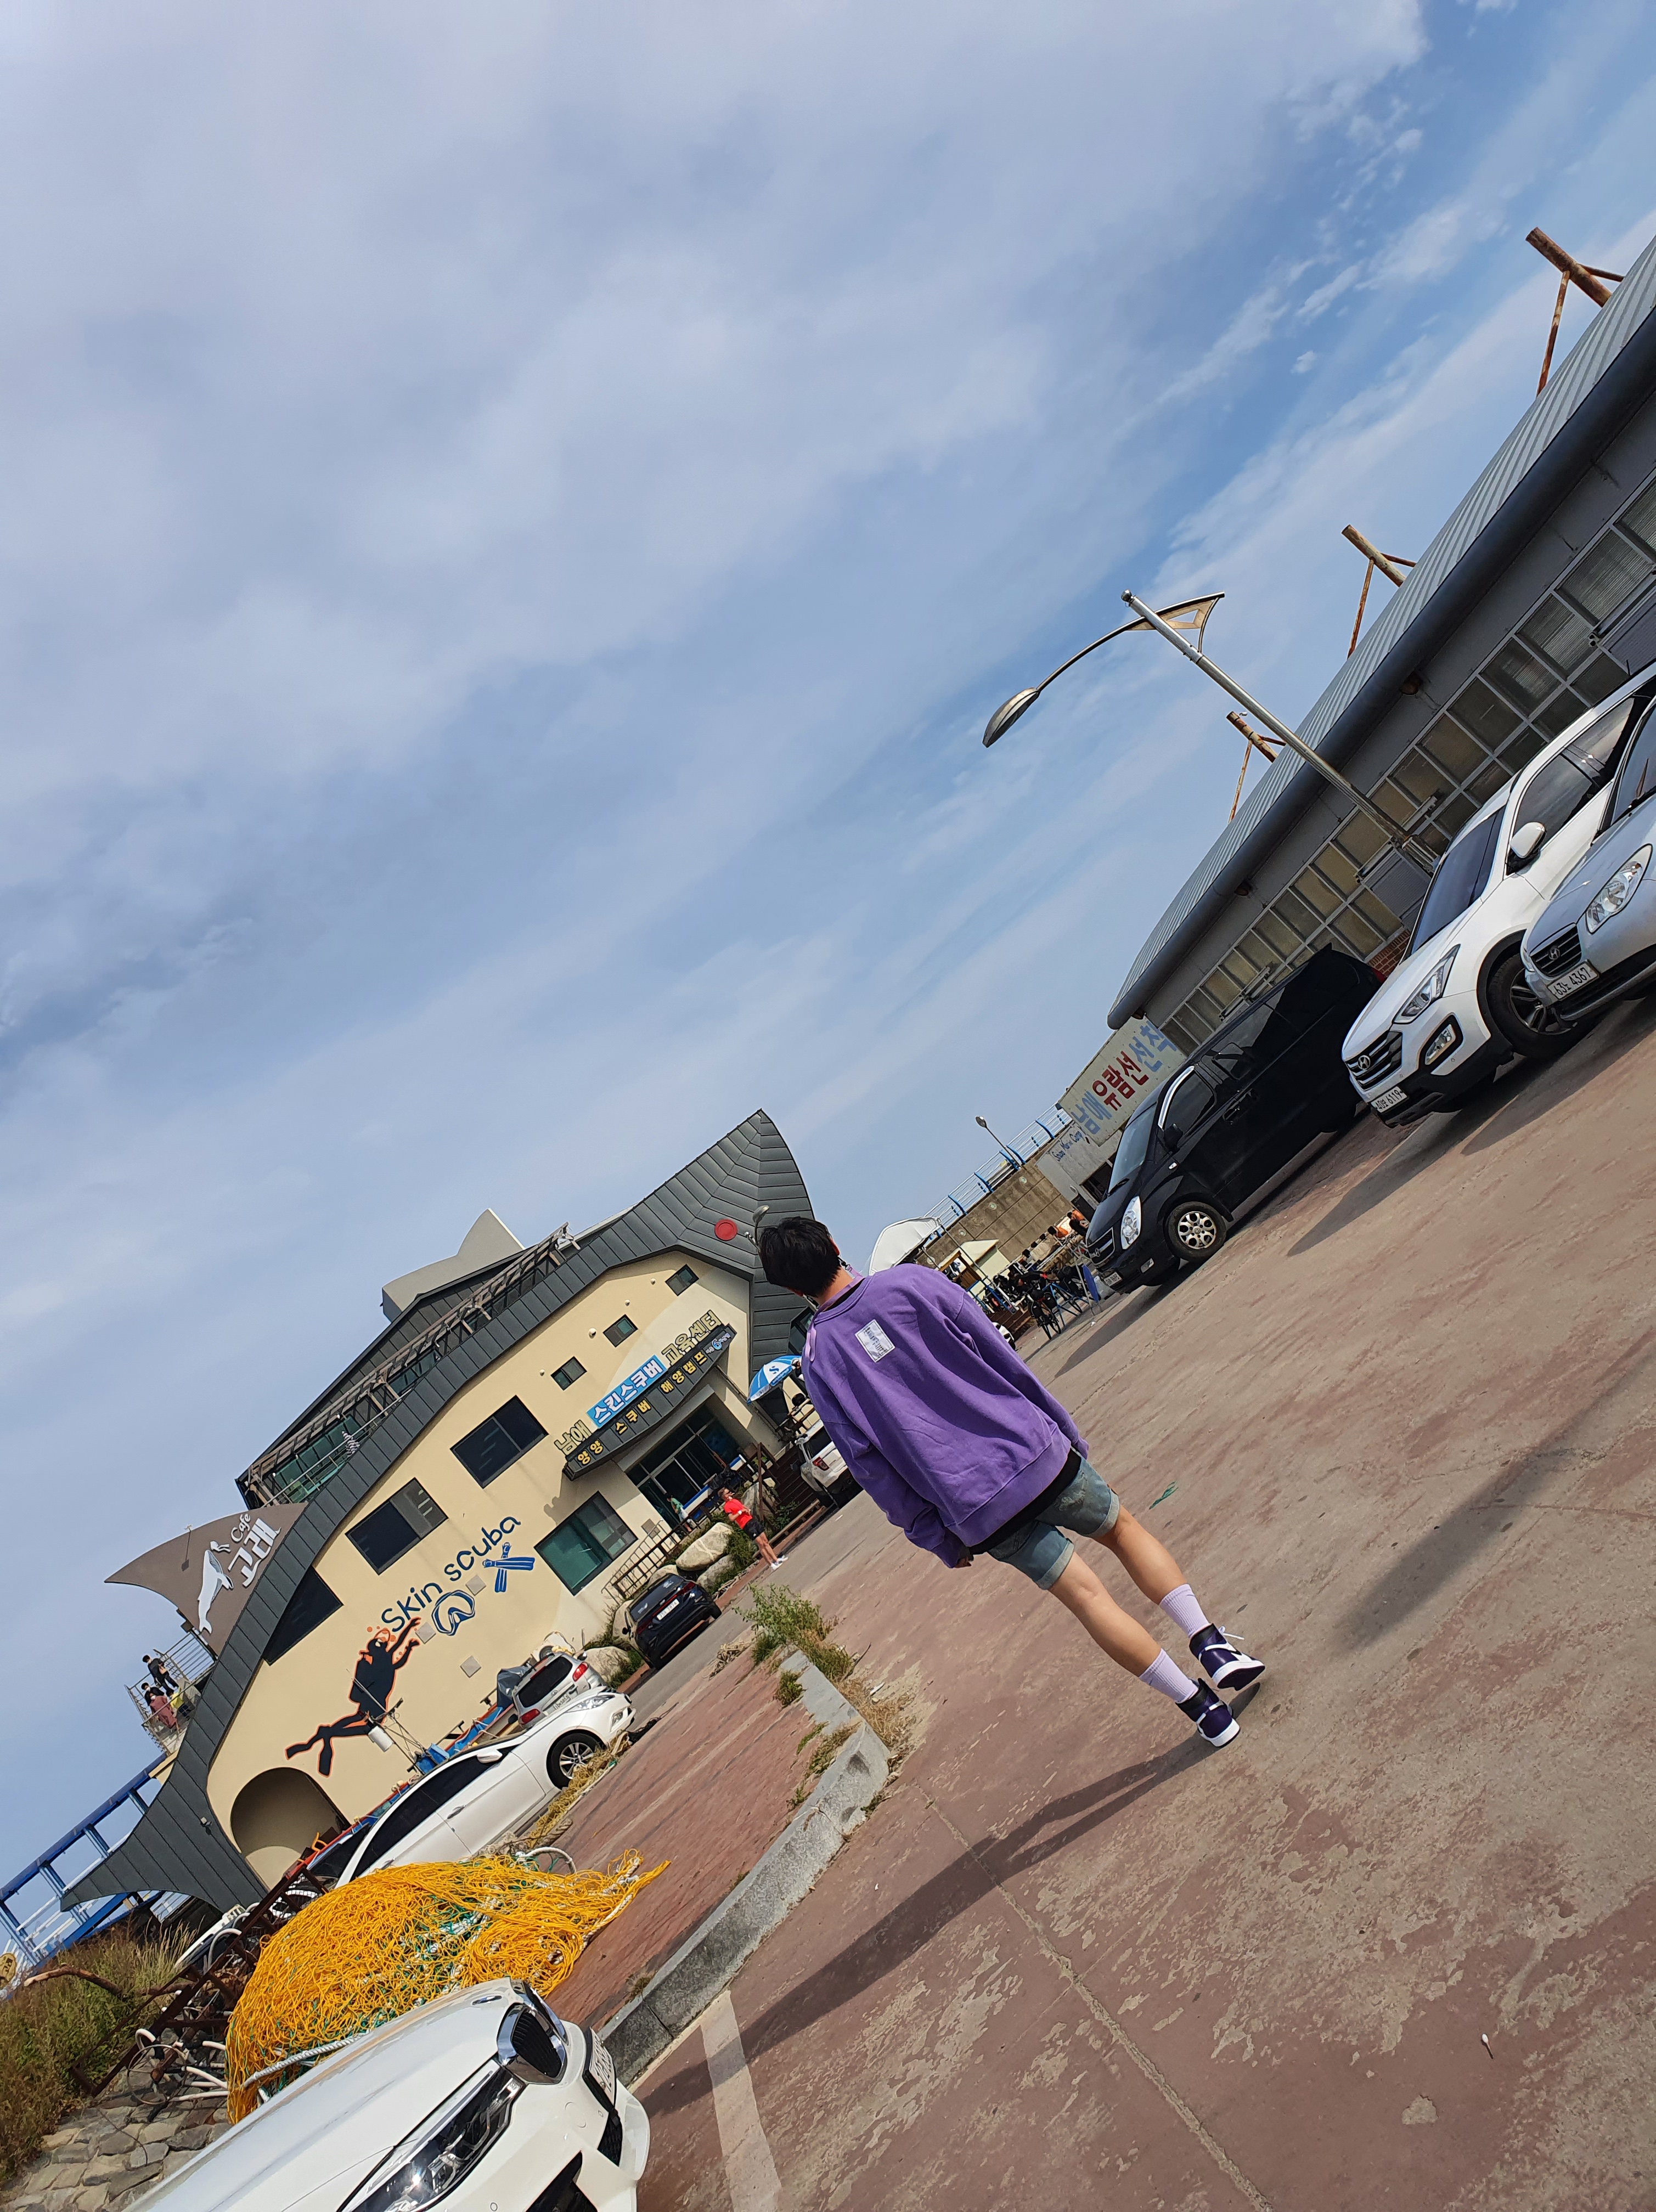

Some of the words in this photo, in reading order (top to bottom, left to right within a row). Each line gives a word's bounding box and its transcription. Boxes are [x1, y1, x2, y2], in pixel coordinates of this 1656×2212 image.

[1571, 967, 1591, 986] 4367
[1387, 1090, 1401, 1104] 6119
[554, 1419, 592, 1455] 남애
[593, 1358, 663, 1424] 스킨스쿠버
[661, 1310, 722, 1366] 교육센터
[577, 1437, 604, 1465] 양양
[615, 1400, 651, 1435] 스쿠버
[660, 1351, 707, 1393] 해양캠프
[227, 1517, 281, 1588] 고래
[230, 1513, 251, 1542] Cafe
[381, 1582, 443, 1632] Skin
[444, 1516, 521, 1582] scuba
